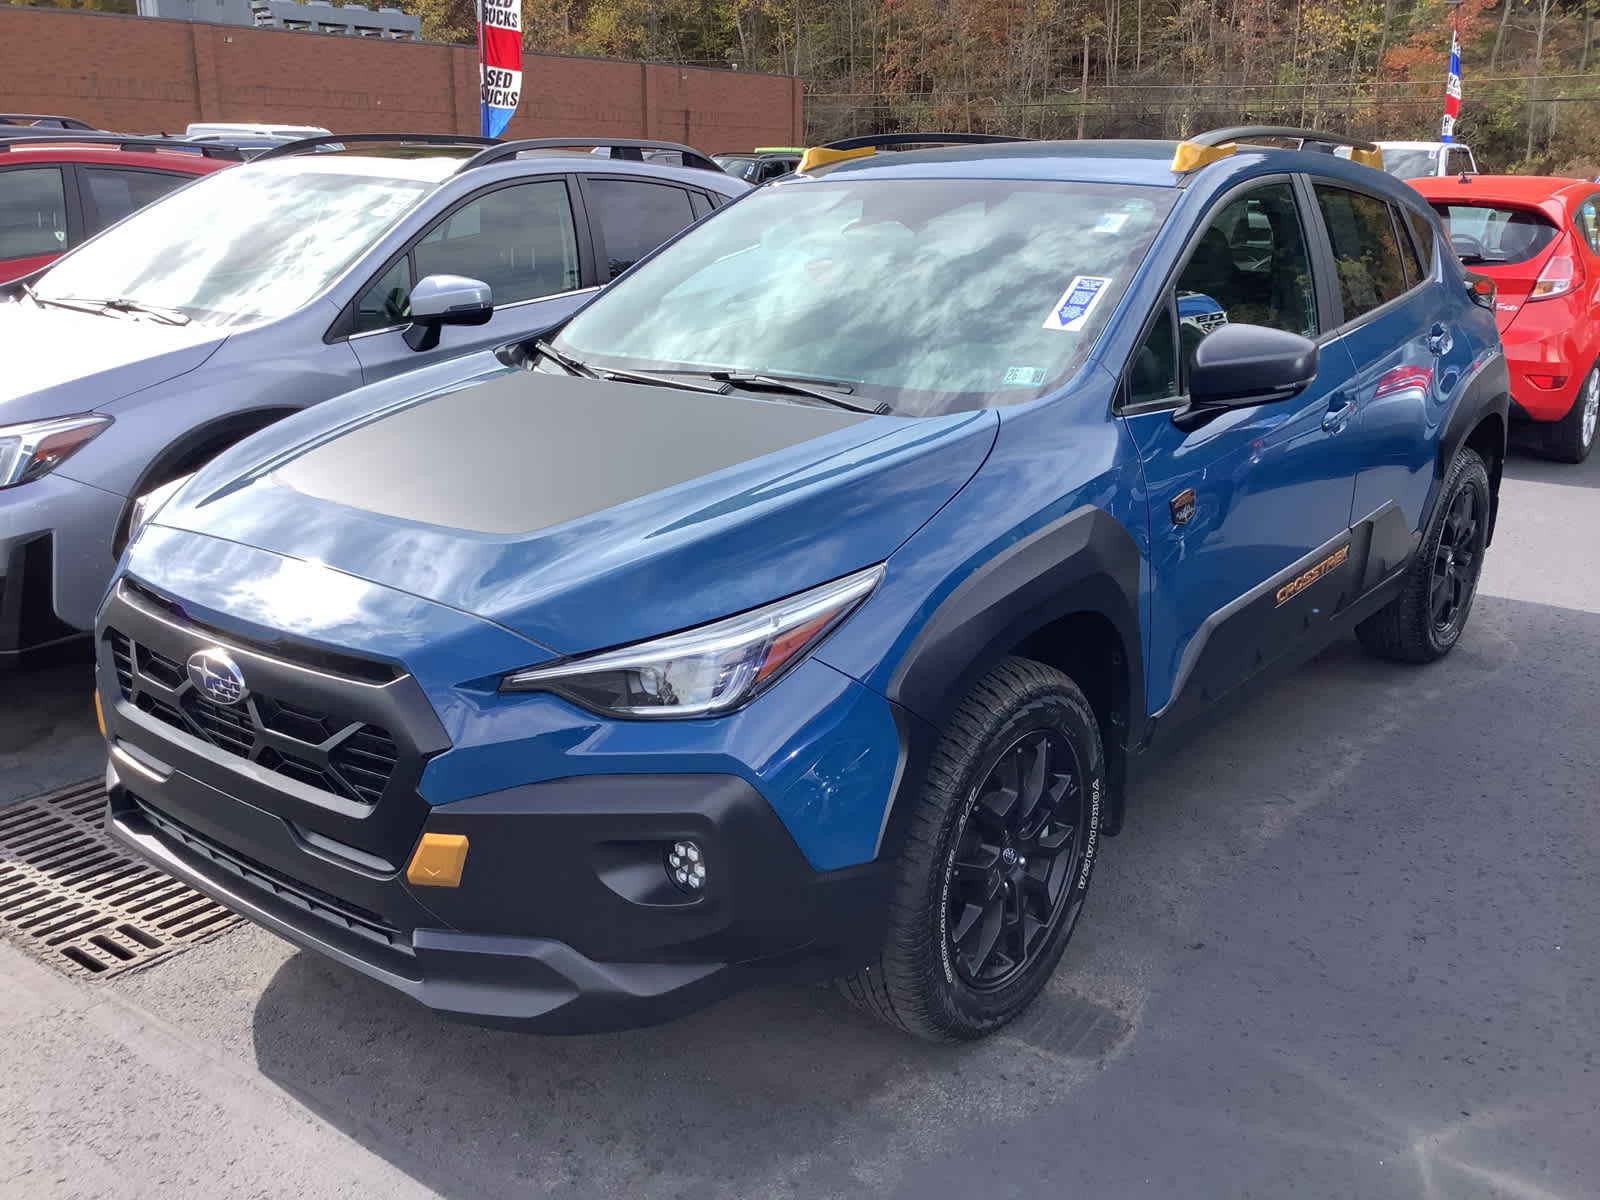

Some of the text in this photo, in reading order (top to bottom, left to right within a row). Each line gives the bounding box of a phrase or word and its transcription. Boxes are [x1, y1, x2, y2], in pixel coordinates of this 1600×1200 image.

[483, 7, 518, 28] UCKS
[486, 69, 513, 89] SED
[483, 88, 518, 107] UCKS
[1276, 544, 1350, 603] CROSSTREK
[1078, 778, 1100, 890] YOKOHAMA
